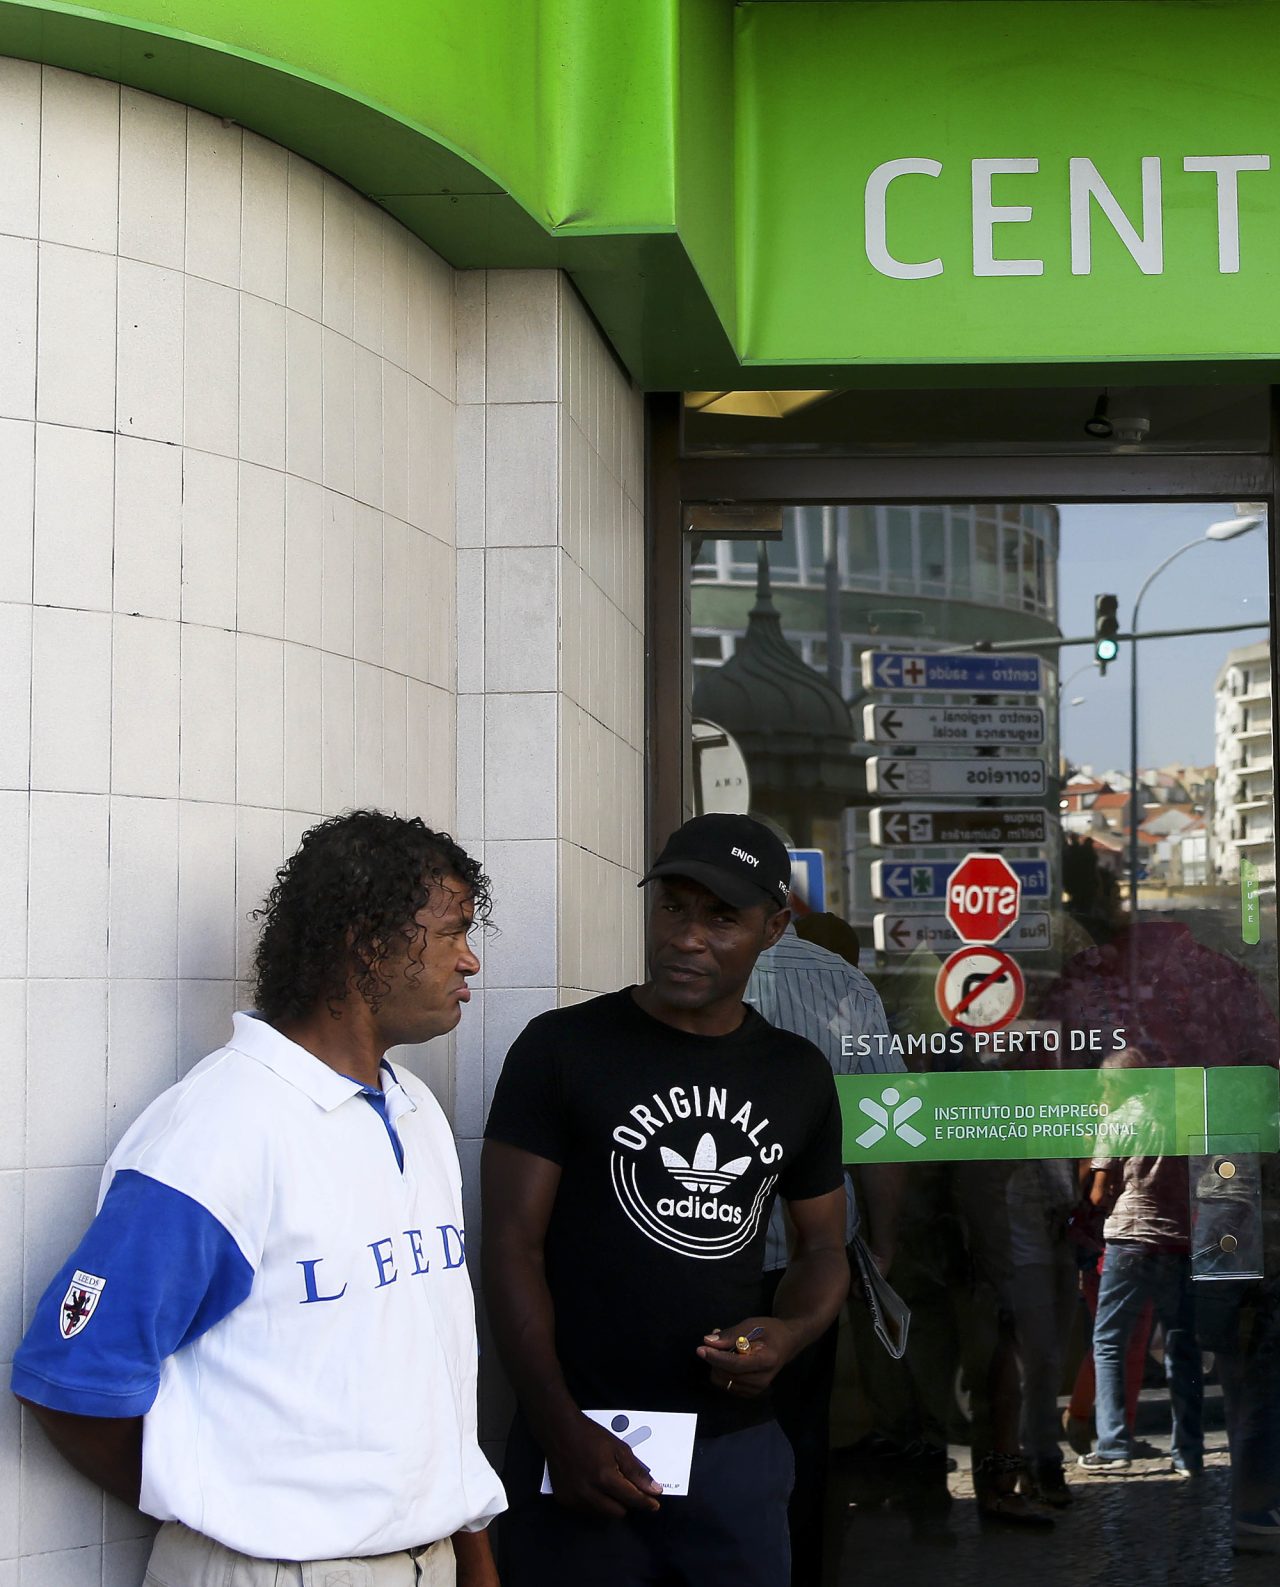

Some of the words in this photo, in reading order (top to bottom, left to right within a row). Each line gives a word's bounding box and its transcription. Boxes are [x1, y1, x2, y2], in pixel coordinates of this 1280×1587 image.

[730, 846, 760, 868] ENJOY
[841, 1031, 964, 1056] ESTAMOS
[974, 1030, 1059, 1053] PERTO
[1070, 1029, 1102, 1051] DE
[1112, 1028, 1127, 1050] S
[934, 1105, 1011, 1120] INSTITUTO
[1014, 1104, 1036, 1119] DO
[1039, 1103, 1109, 1119] EMPREGO
[612, 1085, 783, 1164] ORIGINALS
[934, 1126, 943, 1140] E
[946, 1122, 1028, 1142] FORMAÇÃO
[1033, 1121, 1139, 1138] PROFISSIONAL
[656, 1195, 742, 1225] adidas
[77, 1273, 100, 1287] LEEDS
